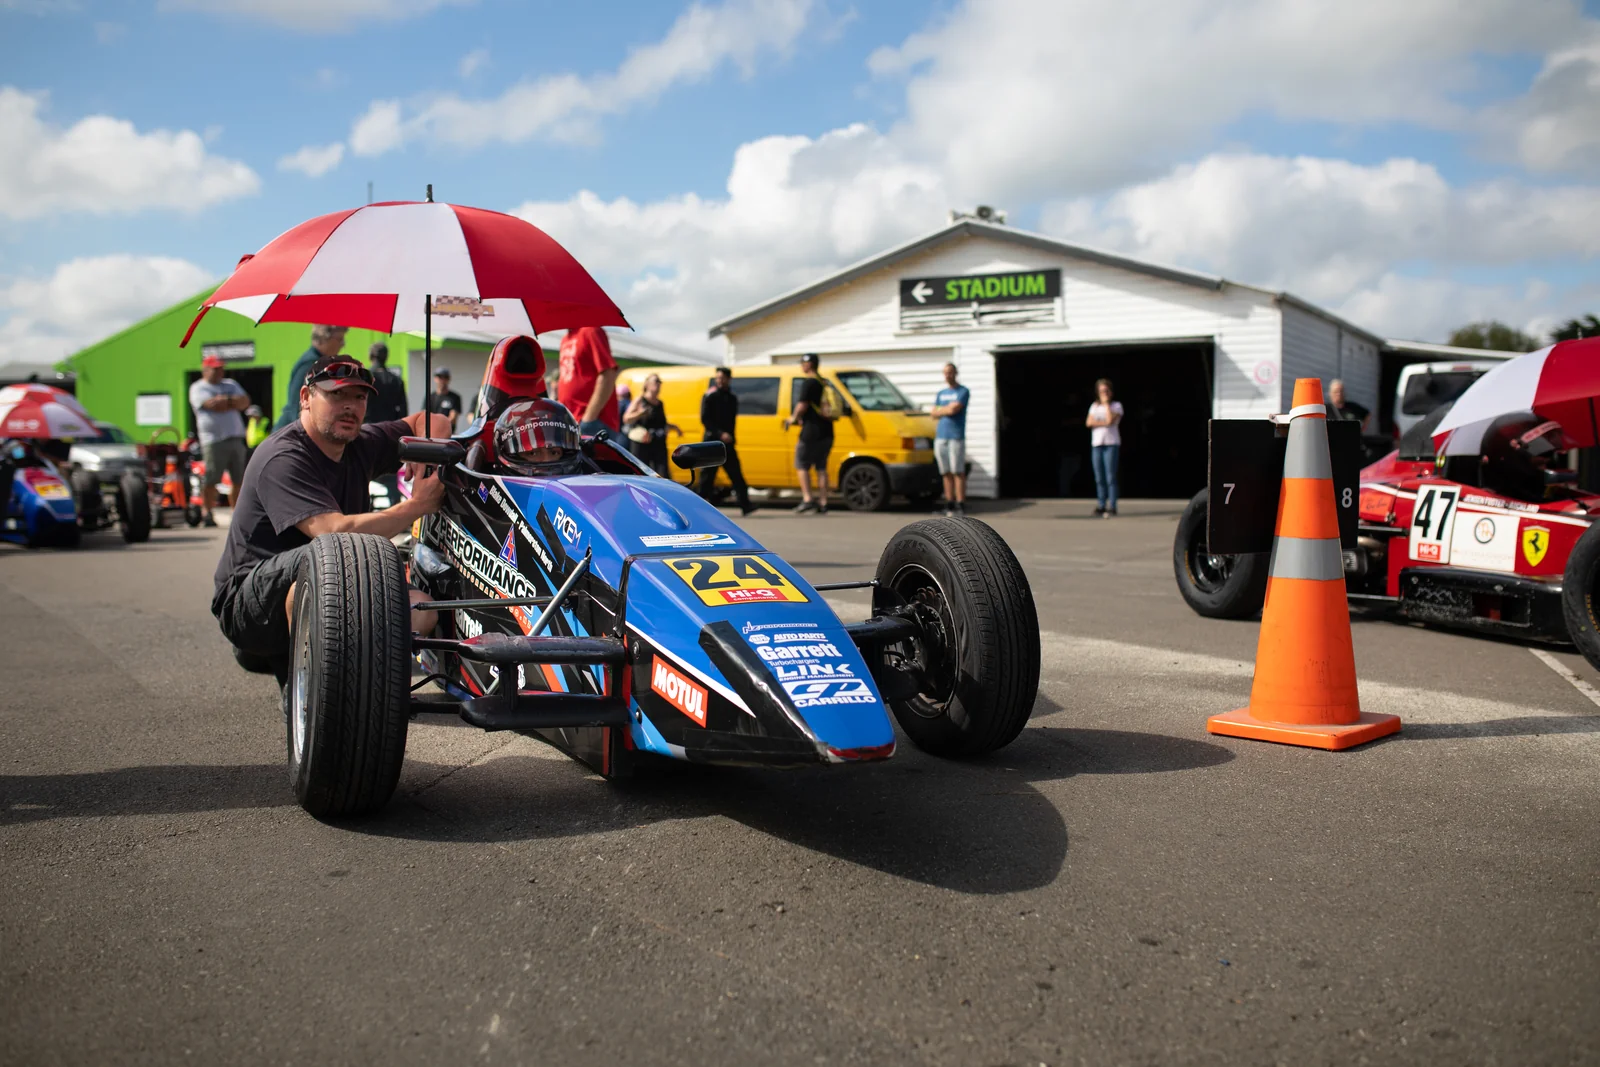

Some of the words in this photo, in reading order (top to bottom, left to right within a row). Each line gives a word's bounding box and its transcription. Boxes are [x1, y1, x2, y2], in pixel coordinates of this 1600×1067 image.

[945, 274, 1046, 300] STADIUM
[515, 421, 566, 433] components
[1223, 483, 1235, 504] 7
[1341, 487, 1353, 508] 8
[1414, 489, 1456, 541] 47
[672, 557, 785, 591] 24
[726, 588, 776, 599] Hi-Q
[774, 633, 798, 641] AUTO
[756, 643, 843, 660] Garrett
[767, 658, 820, 667] Turbochargers
[775, 663, 854, 678] LINK
[653, 663, 705, 720] MOTUL
[794, 696, 877, 707] CARRILLO
